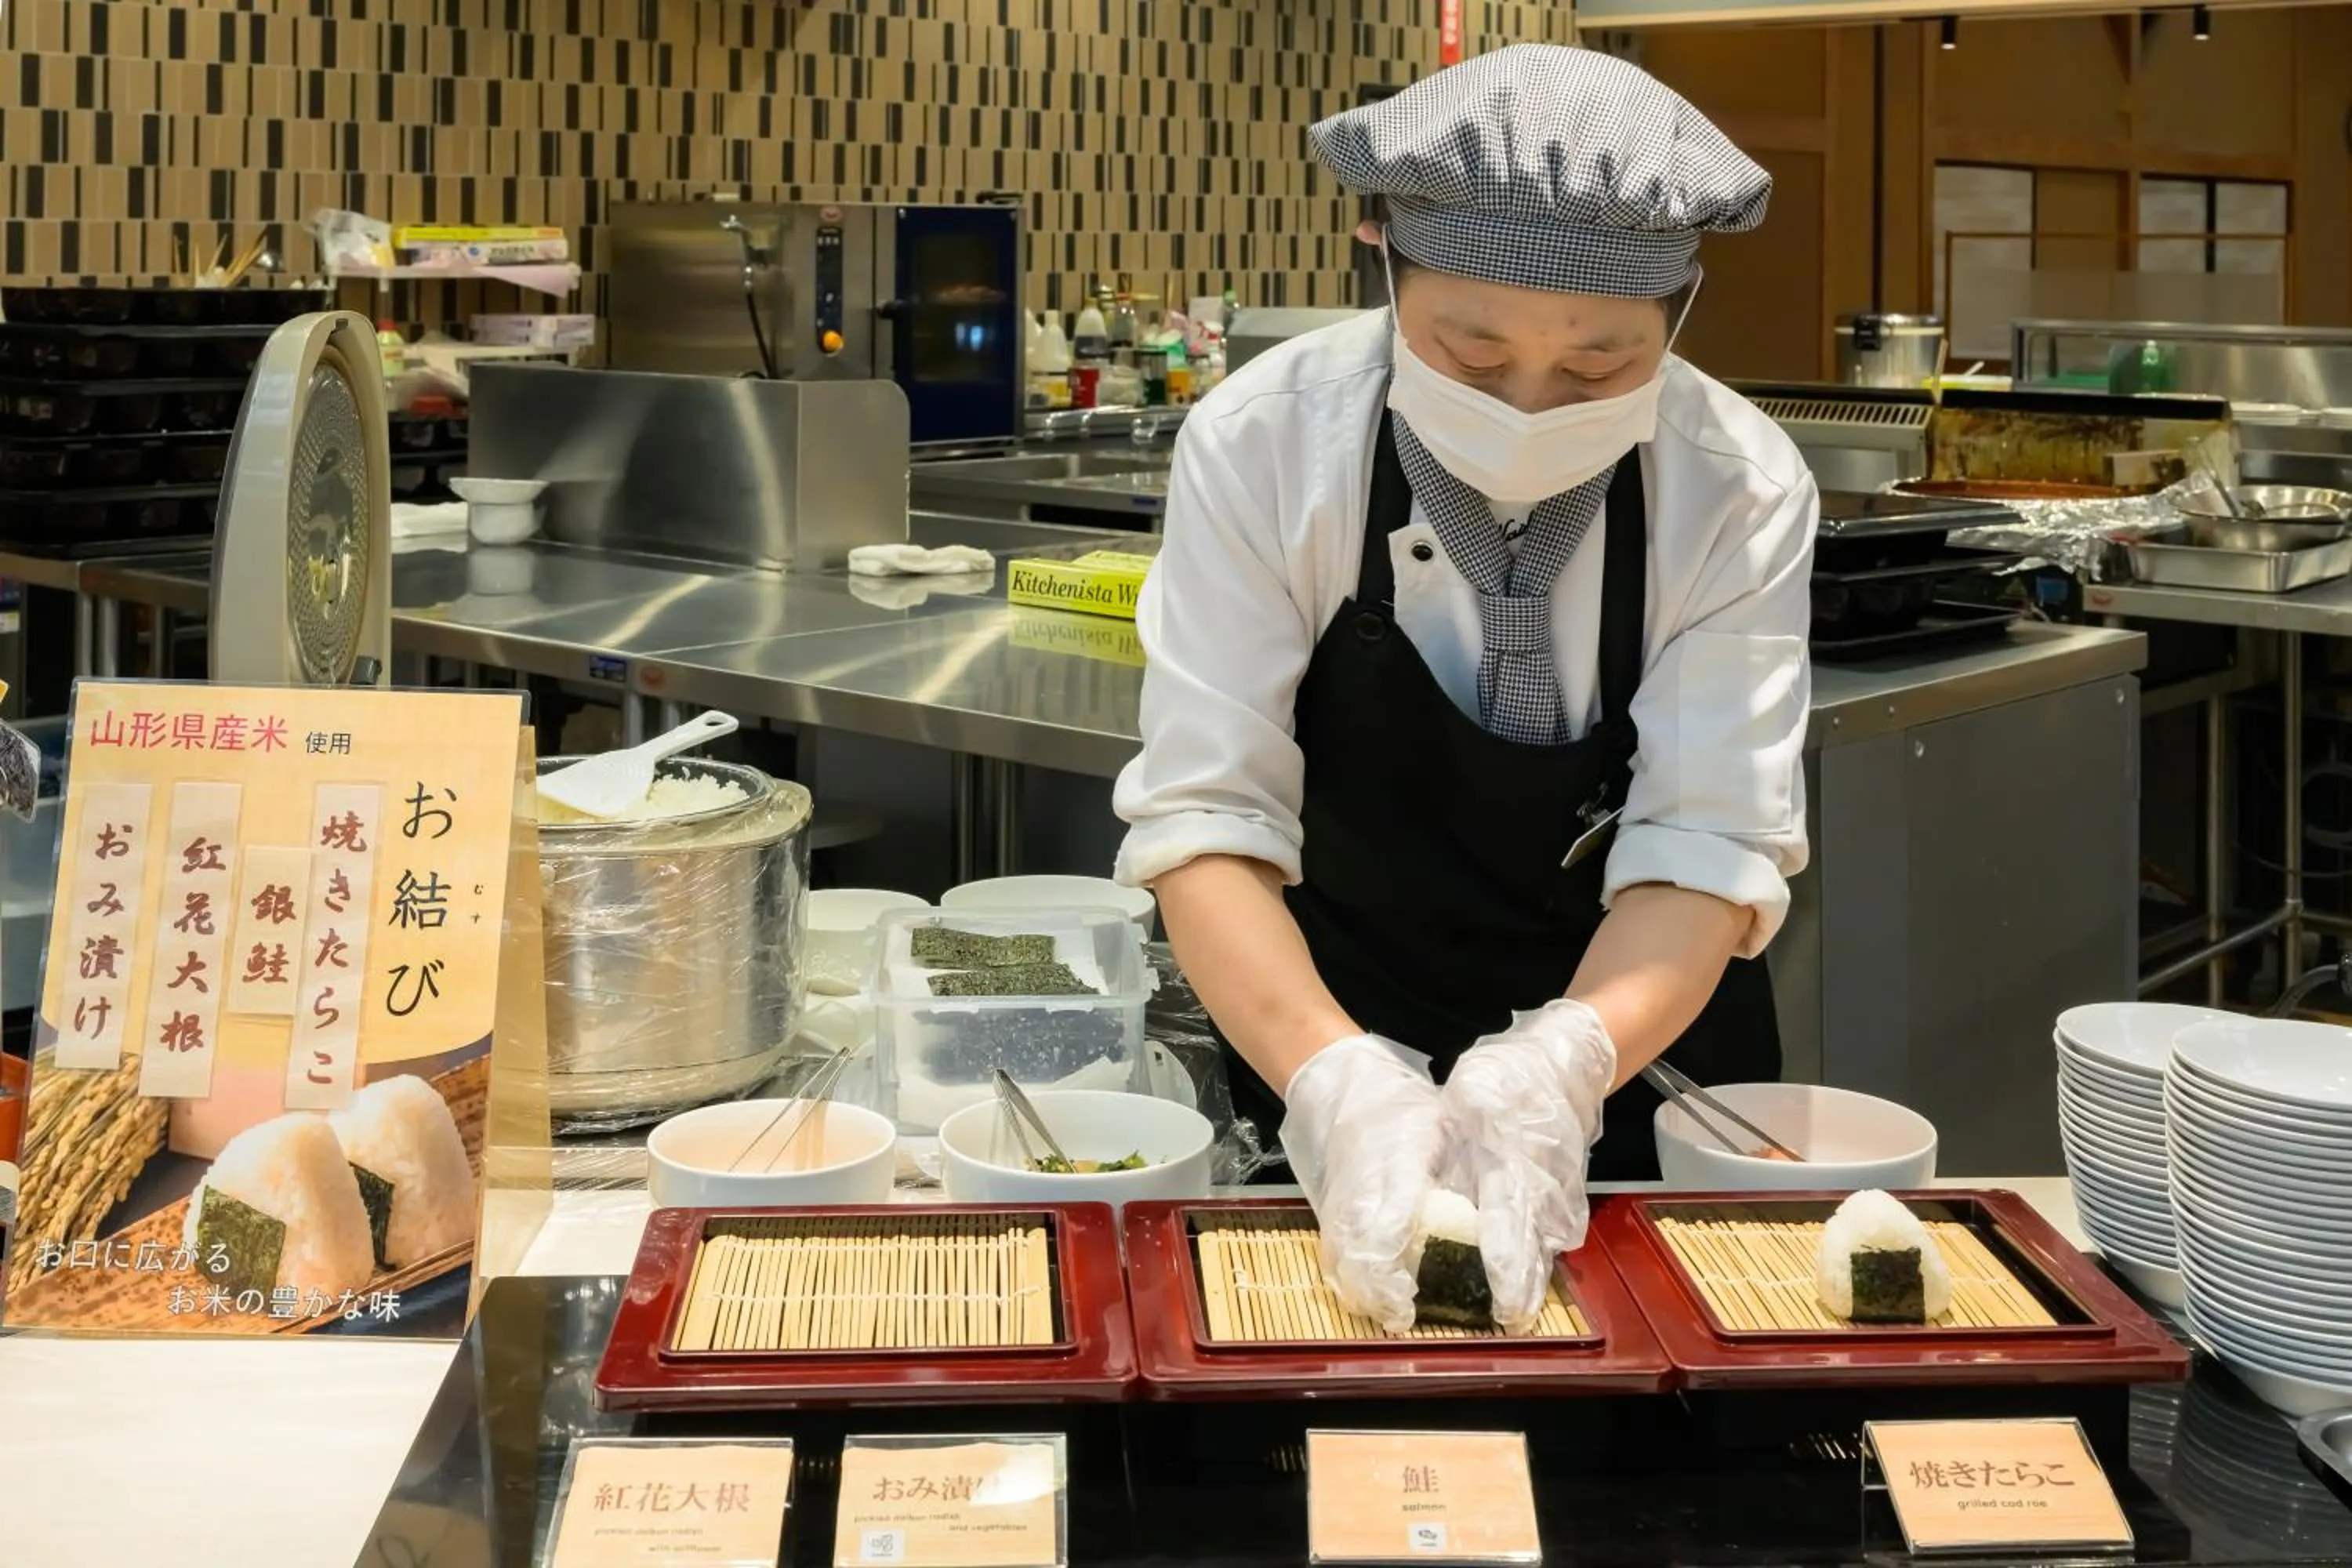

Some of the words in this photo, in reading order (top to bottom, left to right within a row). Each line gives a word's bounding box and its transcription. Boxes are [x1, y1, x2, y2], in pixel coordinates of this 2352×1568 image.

[1012, 570, 1112, 603] Kitchenista
[89, 710, 289, 753] 山形県産米
[305, 731, 352, 755] 使用
[385, 781, 458, 1017] お結び
[73, 822, 133, 1040] おみ漬け
[159, 837, 227, 1052] 紅花大根
[241, 884, 297, 984] 銀鮭
[305, 811, 368, 1086] 焼きたらこ
[34, 1239, 232, 1273] お口に広がる
[167, 1285, 401, 1322] お米の豊かな味
[872, 1474, 1000, 1501] おみ漬
[1909, 1459, 2075, 1489] 焼きたらこ
[593, 1482, 752, 1513] 紅花大根
